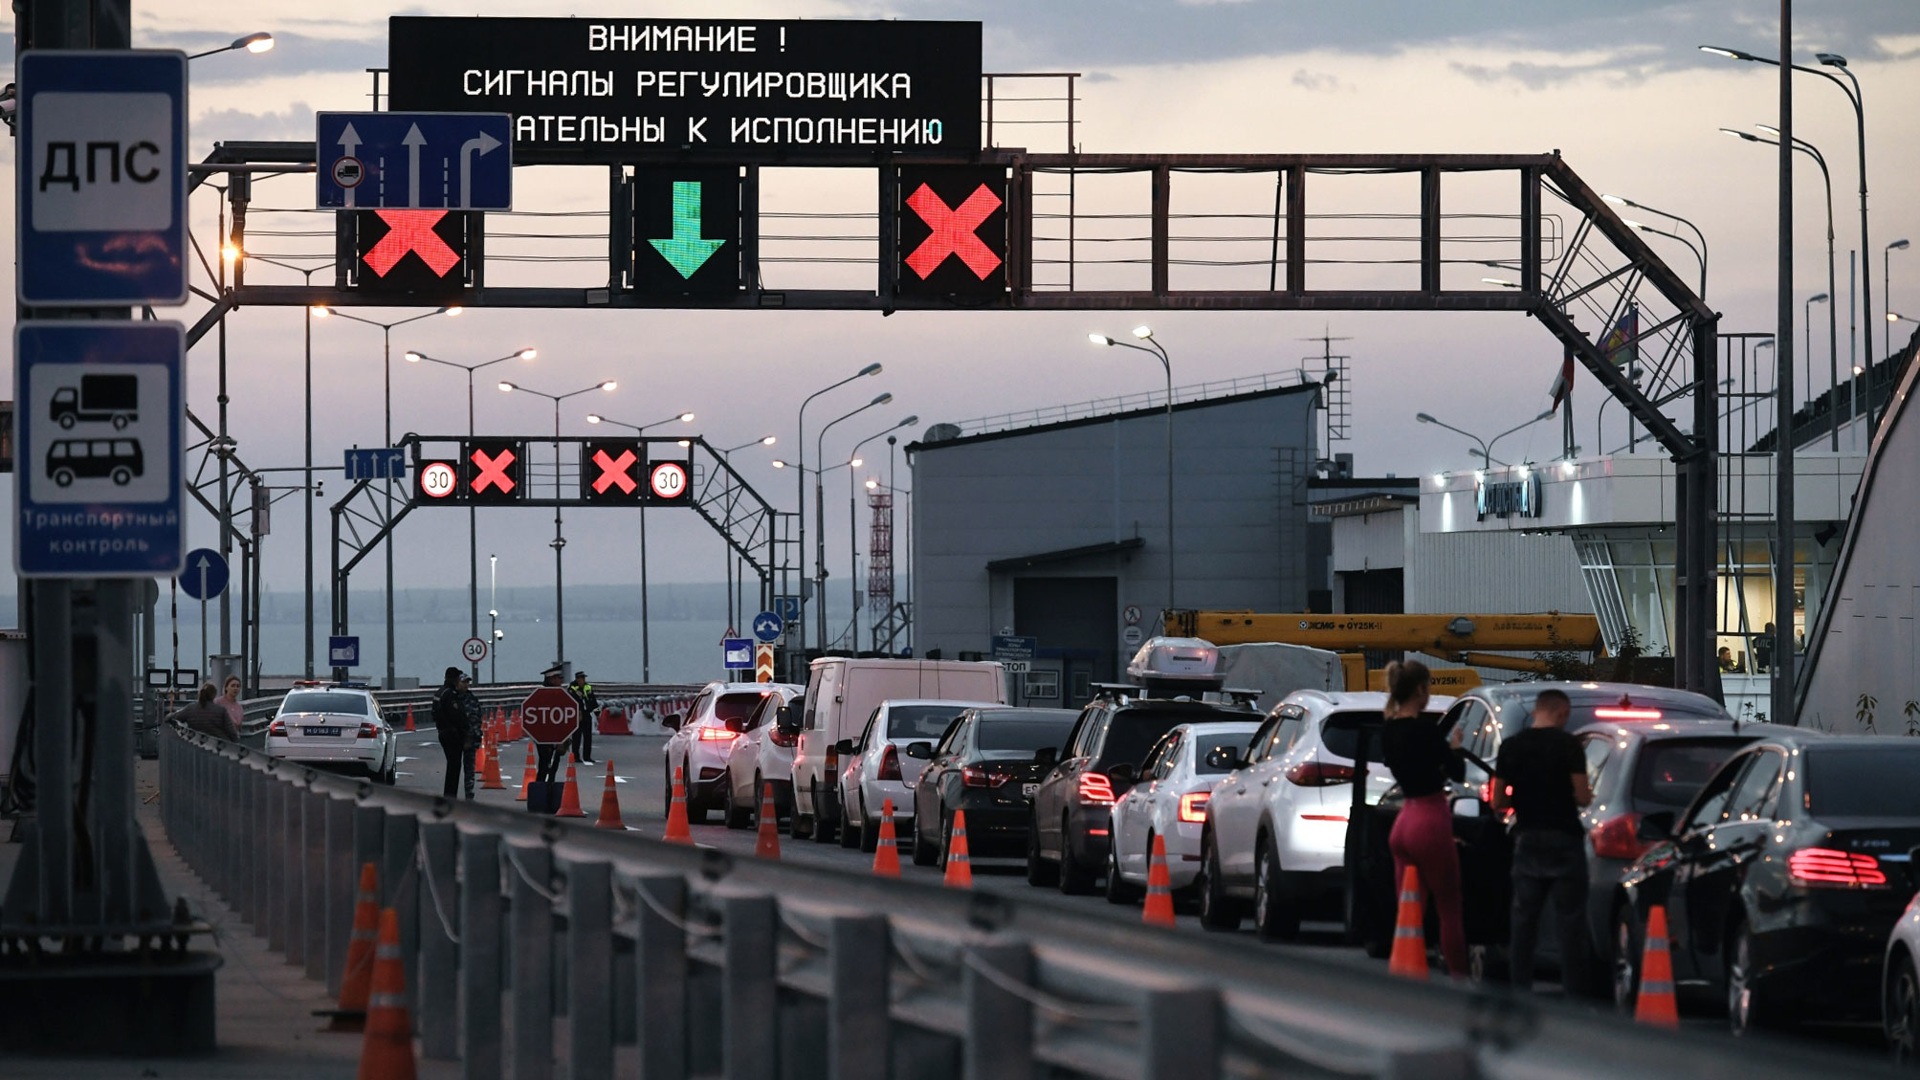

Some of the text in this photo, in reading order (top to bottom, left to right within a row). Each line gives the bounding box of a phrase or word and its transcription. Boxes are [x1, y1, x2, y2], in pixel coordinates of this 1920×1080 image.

[588, 25, 785, 53] ВНИМАНИЕ !
[463, 69, 911, 101] СИГНАЛЫ РЕГУЛИРОВЩИКА
[516, 115, 942, 145] АТЕЛЬНЫ К ИСПОЛНЕНИЮ
[39, 141, 160, 192] ДПС
[428, 471, 448, 489] 30
[658, 472, 679, 489] 30
[23, 508, 177, 531] Транспортный
[50, 538, 149, 556] контроль
[468, 644, 482, 655] 30
[524, 706, 576, 725] STOP
